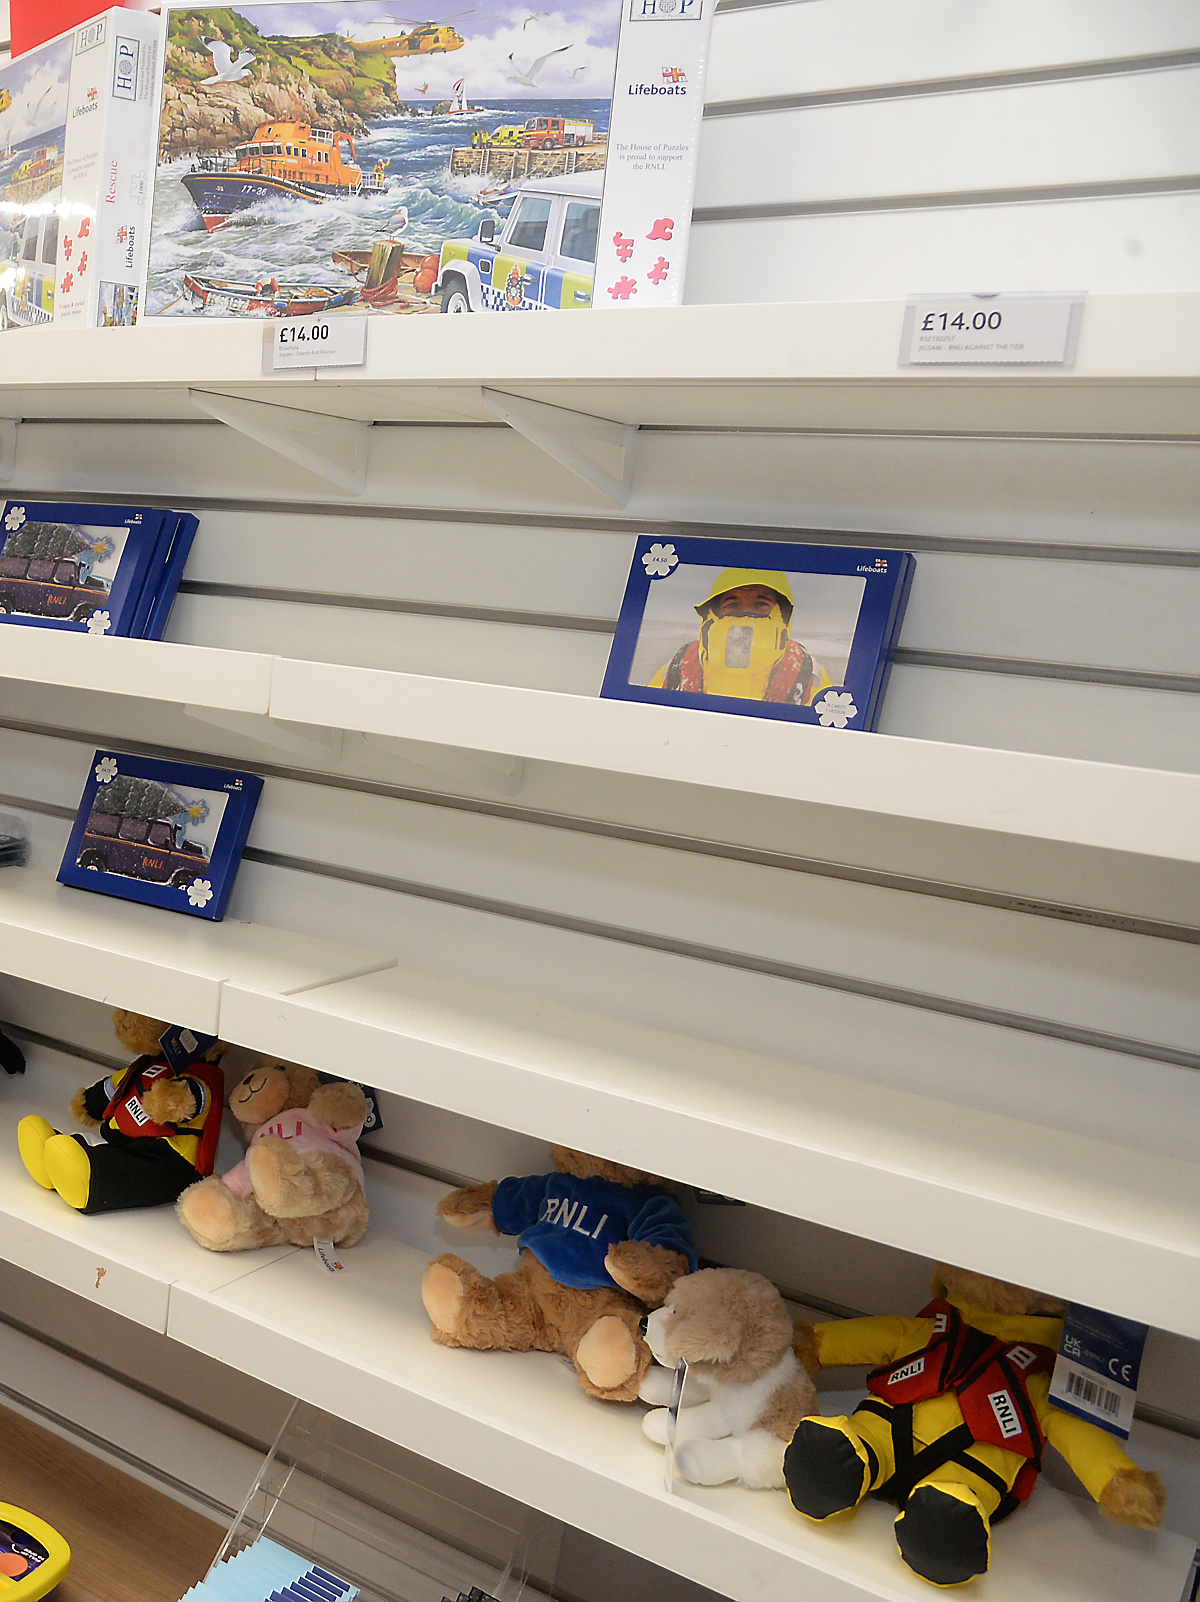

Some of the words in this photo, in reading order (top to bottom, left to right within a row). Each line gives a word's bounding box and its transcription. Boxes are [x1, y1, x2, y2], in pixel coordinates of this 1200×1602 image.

[627, 83, 687, 97] Lifeboats
[72, 101, 98, 119] Lifeboats
[615, 143, 628, 151] The
[630, 143, 652, 151] House
[654, 143, 662, 151] of
[663, 143, 689, 151] Puzzles
[619, 153, 626, 161] is
[626, 153, 647, 162] proud
[657, 153, 683, 162] support
[632, 162, 644, 170] the
[105, 160, 118, 204] Rescue
[240, 184, 268, 196] 17-36
[125, 226, 136, 269] Lifeboats
[921, 311, 1003, 331] £14.00
[279, 324, 329, 343] £14.00
[652, 556, 668, 564] £4.50
[856, 564, 888, 574] Lifeboats
[47, 595, 67, 605] RNLI
[831, 702, 847, 710] CARDS
[142, 858, 164, 870] RNLI
[170, 1037, 181, 1055] MILLY
[127, 1098, 147, 1124] RNLI
[539, 1197, 609, 1240] RNLI
[317, 1247, 336, 1273] Lifeboats
[1064, 1333, 1082, 1348] UK
[889, 1361, 923, 1384] RNLI
[1108, 1357, 1132, 1382] CE
[991, 1393, 1019, 1436] RNLI
